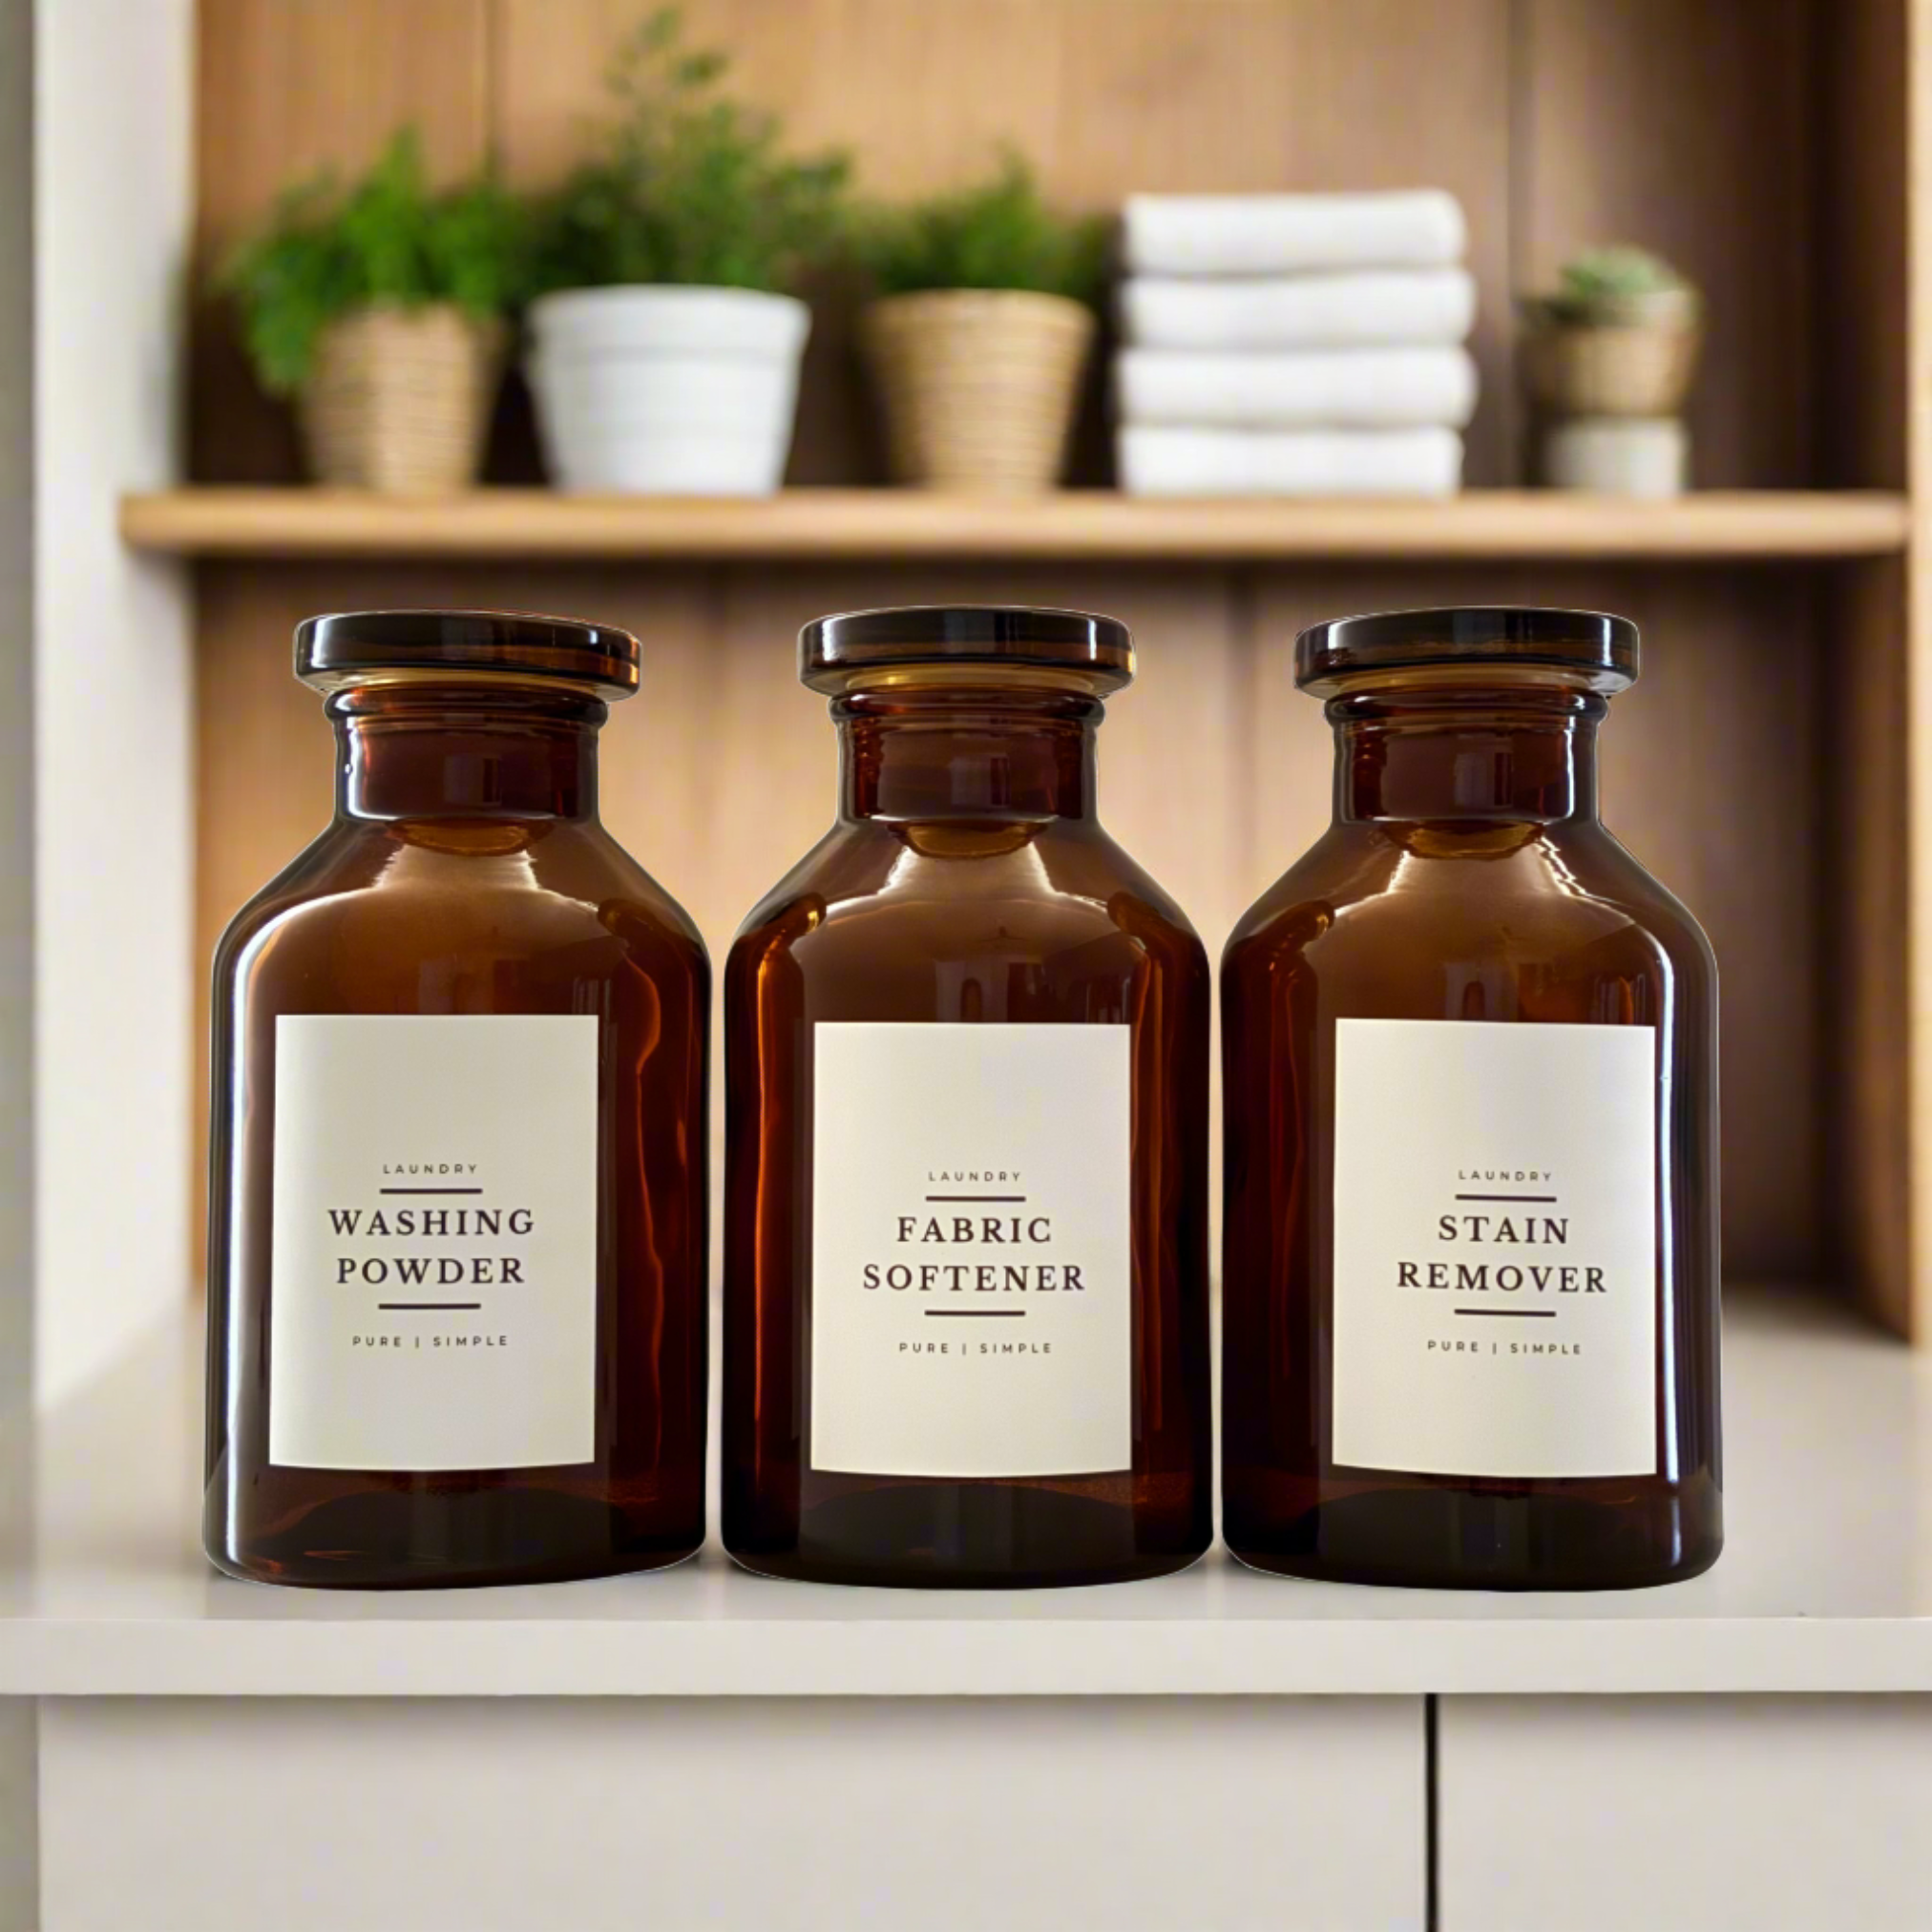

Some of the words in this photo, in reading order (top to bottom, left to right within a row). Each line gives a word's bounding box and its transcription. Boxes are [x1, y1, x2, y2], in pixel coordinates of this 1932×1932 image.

[383, 1164, 477, 1175] LAUNDRY
[928, 1170, 1020, 1182] LAUNDRY
[1459, 1170, 1552, 1182] LAUNDRY
[327, 1208, 535, 1236] WASHING
[896, 1216, 1052, 1244] FABRIC
[1438, 1215, 1569, 1245] STAIN
[336, 1257, 526, 1285] POWDER
[863, 1263, 1085, 1292] SOFTENER
[1396, 1261, 1607, 1293] REMOVER
[352, 1335, 403, 1347] PURE
[432, 1334, 508, 1347] SIMPLE
[898, 1342, 950, 1354] PURE
[979, 1342, 1052, 1354] SIMPLE
[1427, 1339, 1480, 1354] PURE
[1510, 1342, 1581, 1355] SIMPLE
